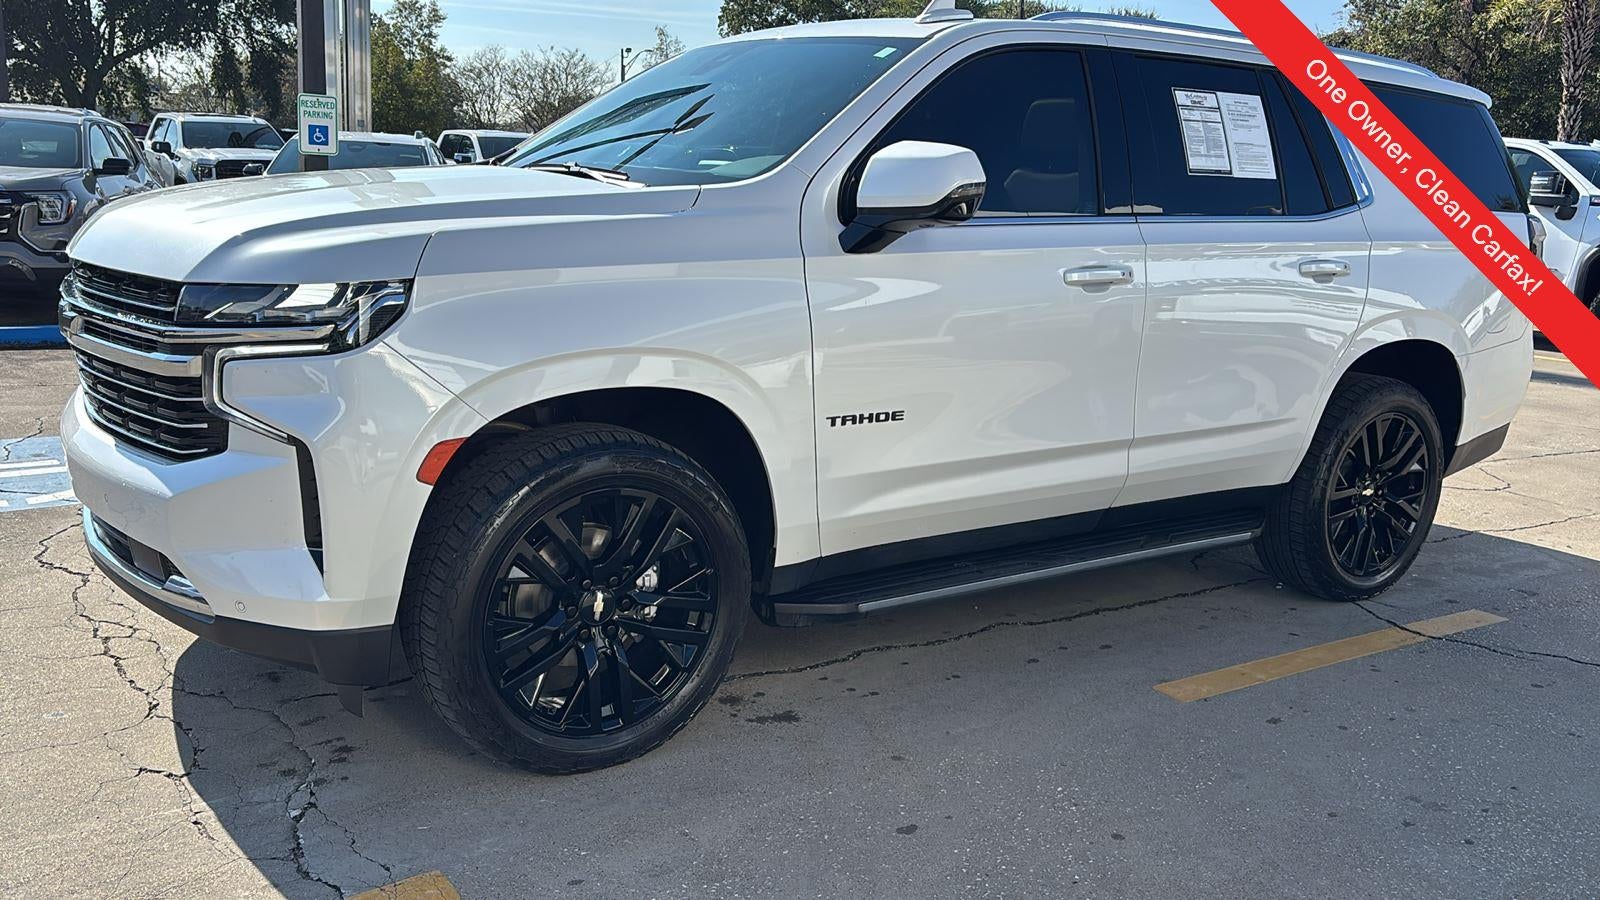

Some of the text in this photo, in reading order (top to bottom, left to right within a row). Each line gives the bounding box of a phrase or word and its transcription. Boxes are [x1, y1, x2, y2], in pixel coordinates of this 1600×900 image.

[300, 99, 335, 110] RESERVED
[303, 110, 333, 120] PARKING
[825, 410, 905, 427] TAHOE
